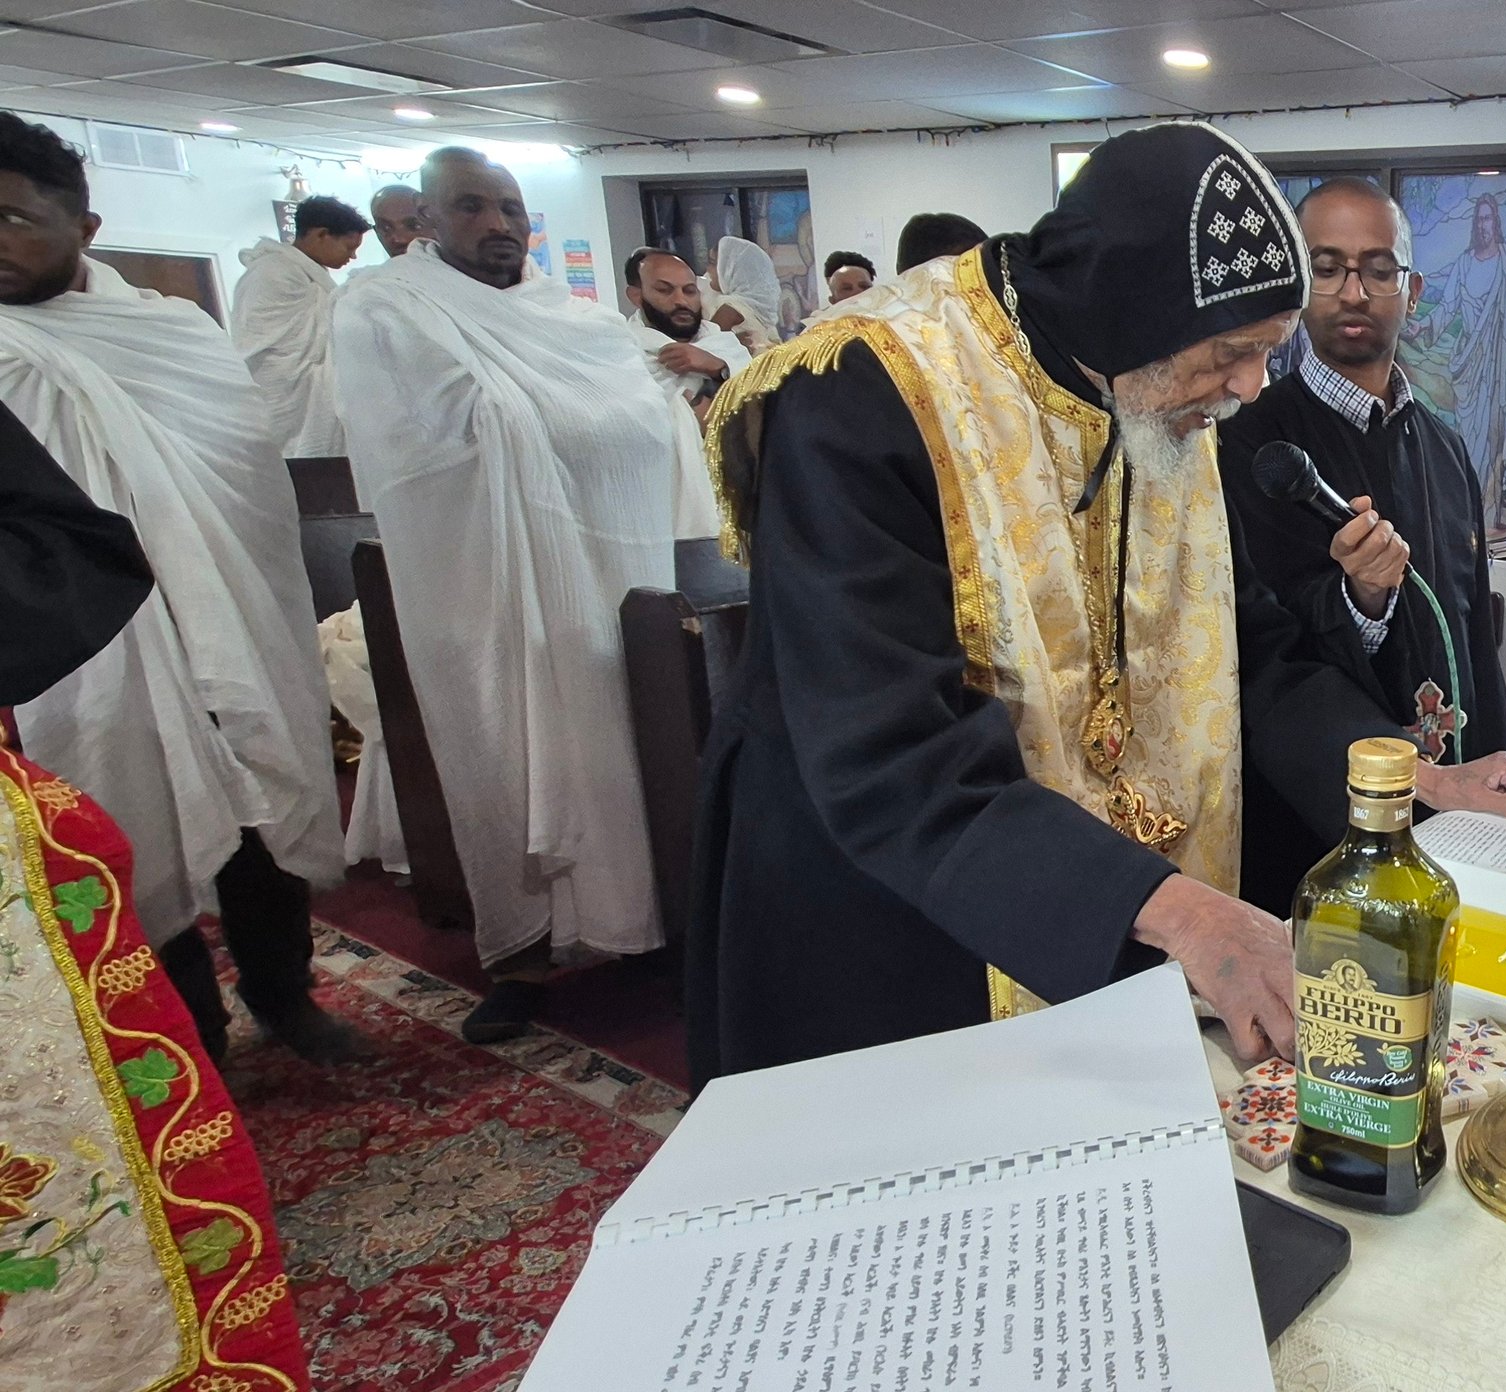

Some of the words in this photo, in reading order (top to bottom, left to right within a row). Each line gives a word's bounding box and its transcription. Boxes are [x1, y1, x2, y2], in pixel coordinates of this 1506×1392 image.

[1353, 806, 1369, 820] 1867
[1299, 996, 1402, 1035] BERIO
[1305, 986, 1396, 1016] FILIPPO
[1307, 1081, 1346, 1098] EXTRA
[1349, 1092, 1390, 1111] VIRGIN
[1329, 1095, 1351, 1106] OLIVE
[1352, 1101, 1366, 1110] OIL
[1304, 1102, 1343, 1122] EXTRA
[1346, 1114, 1391, 1134] VIERGE
[1341, 1125, 1366, 1139] 750ml
